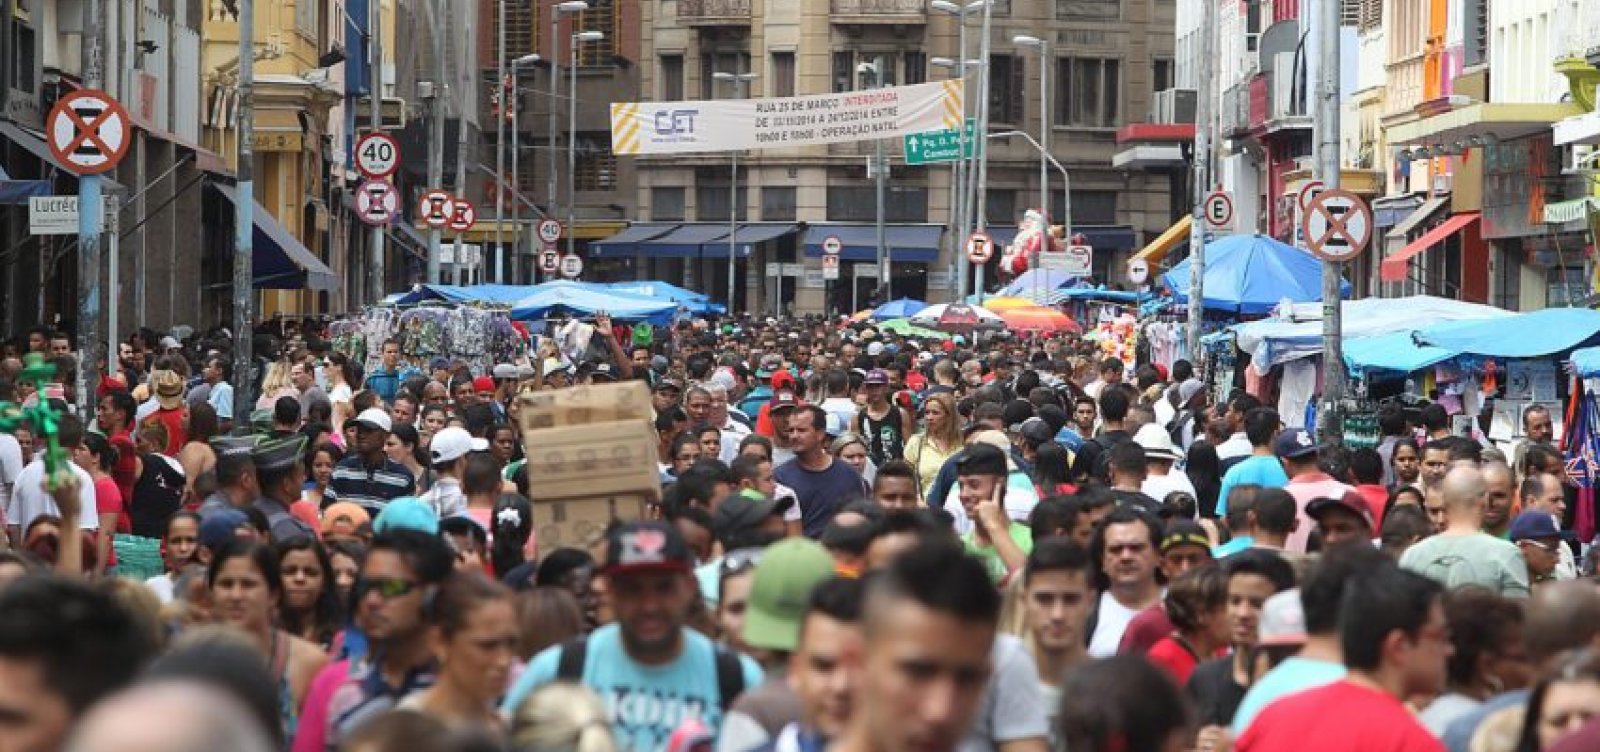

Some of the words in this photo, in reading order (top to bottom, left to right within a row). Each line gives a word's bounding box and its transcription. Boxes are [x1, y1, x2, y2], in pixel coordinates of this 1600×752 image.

[756, 101, 776, 113] RUA
[778, 102, 790, 112] 25
[791, 101, 804, 111] DE
[807, 99, 840, 111] MARÇO
[844, 93, 898, 106] INTERDITADA
[654, 109, 699, 135] CET
[755, 117, 769, 128] DE
[818, 114, 825, 123] A
[871, 106, 898, 118] ENTRE
[782, 130, 788, 141] E
[821, 123, 870, 138] OPERAÇÃO
[872, 121, 898, 132] NATAL
[362, 142, 392, 161] 40
[1213, 200, 1224, 219] E
[543, 224, 558, 235] 40
